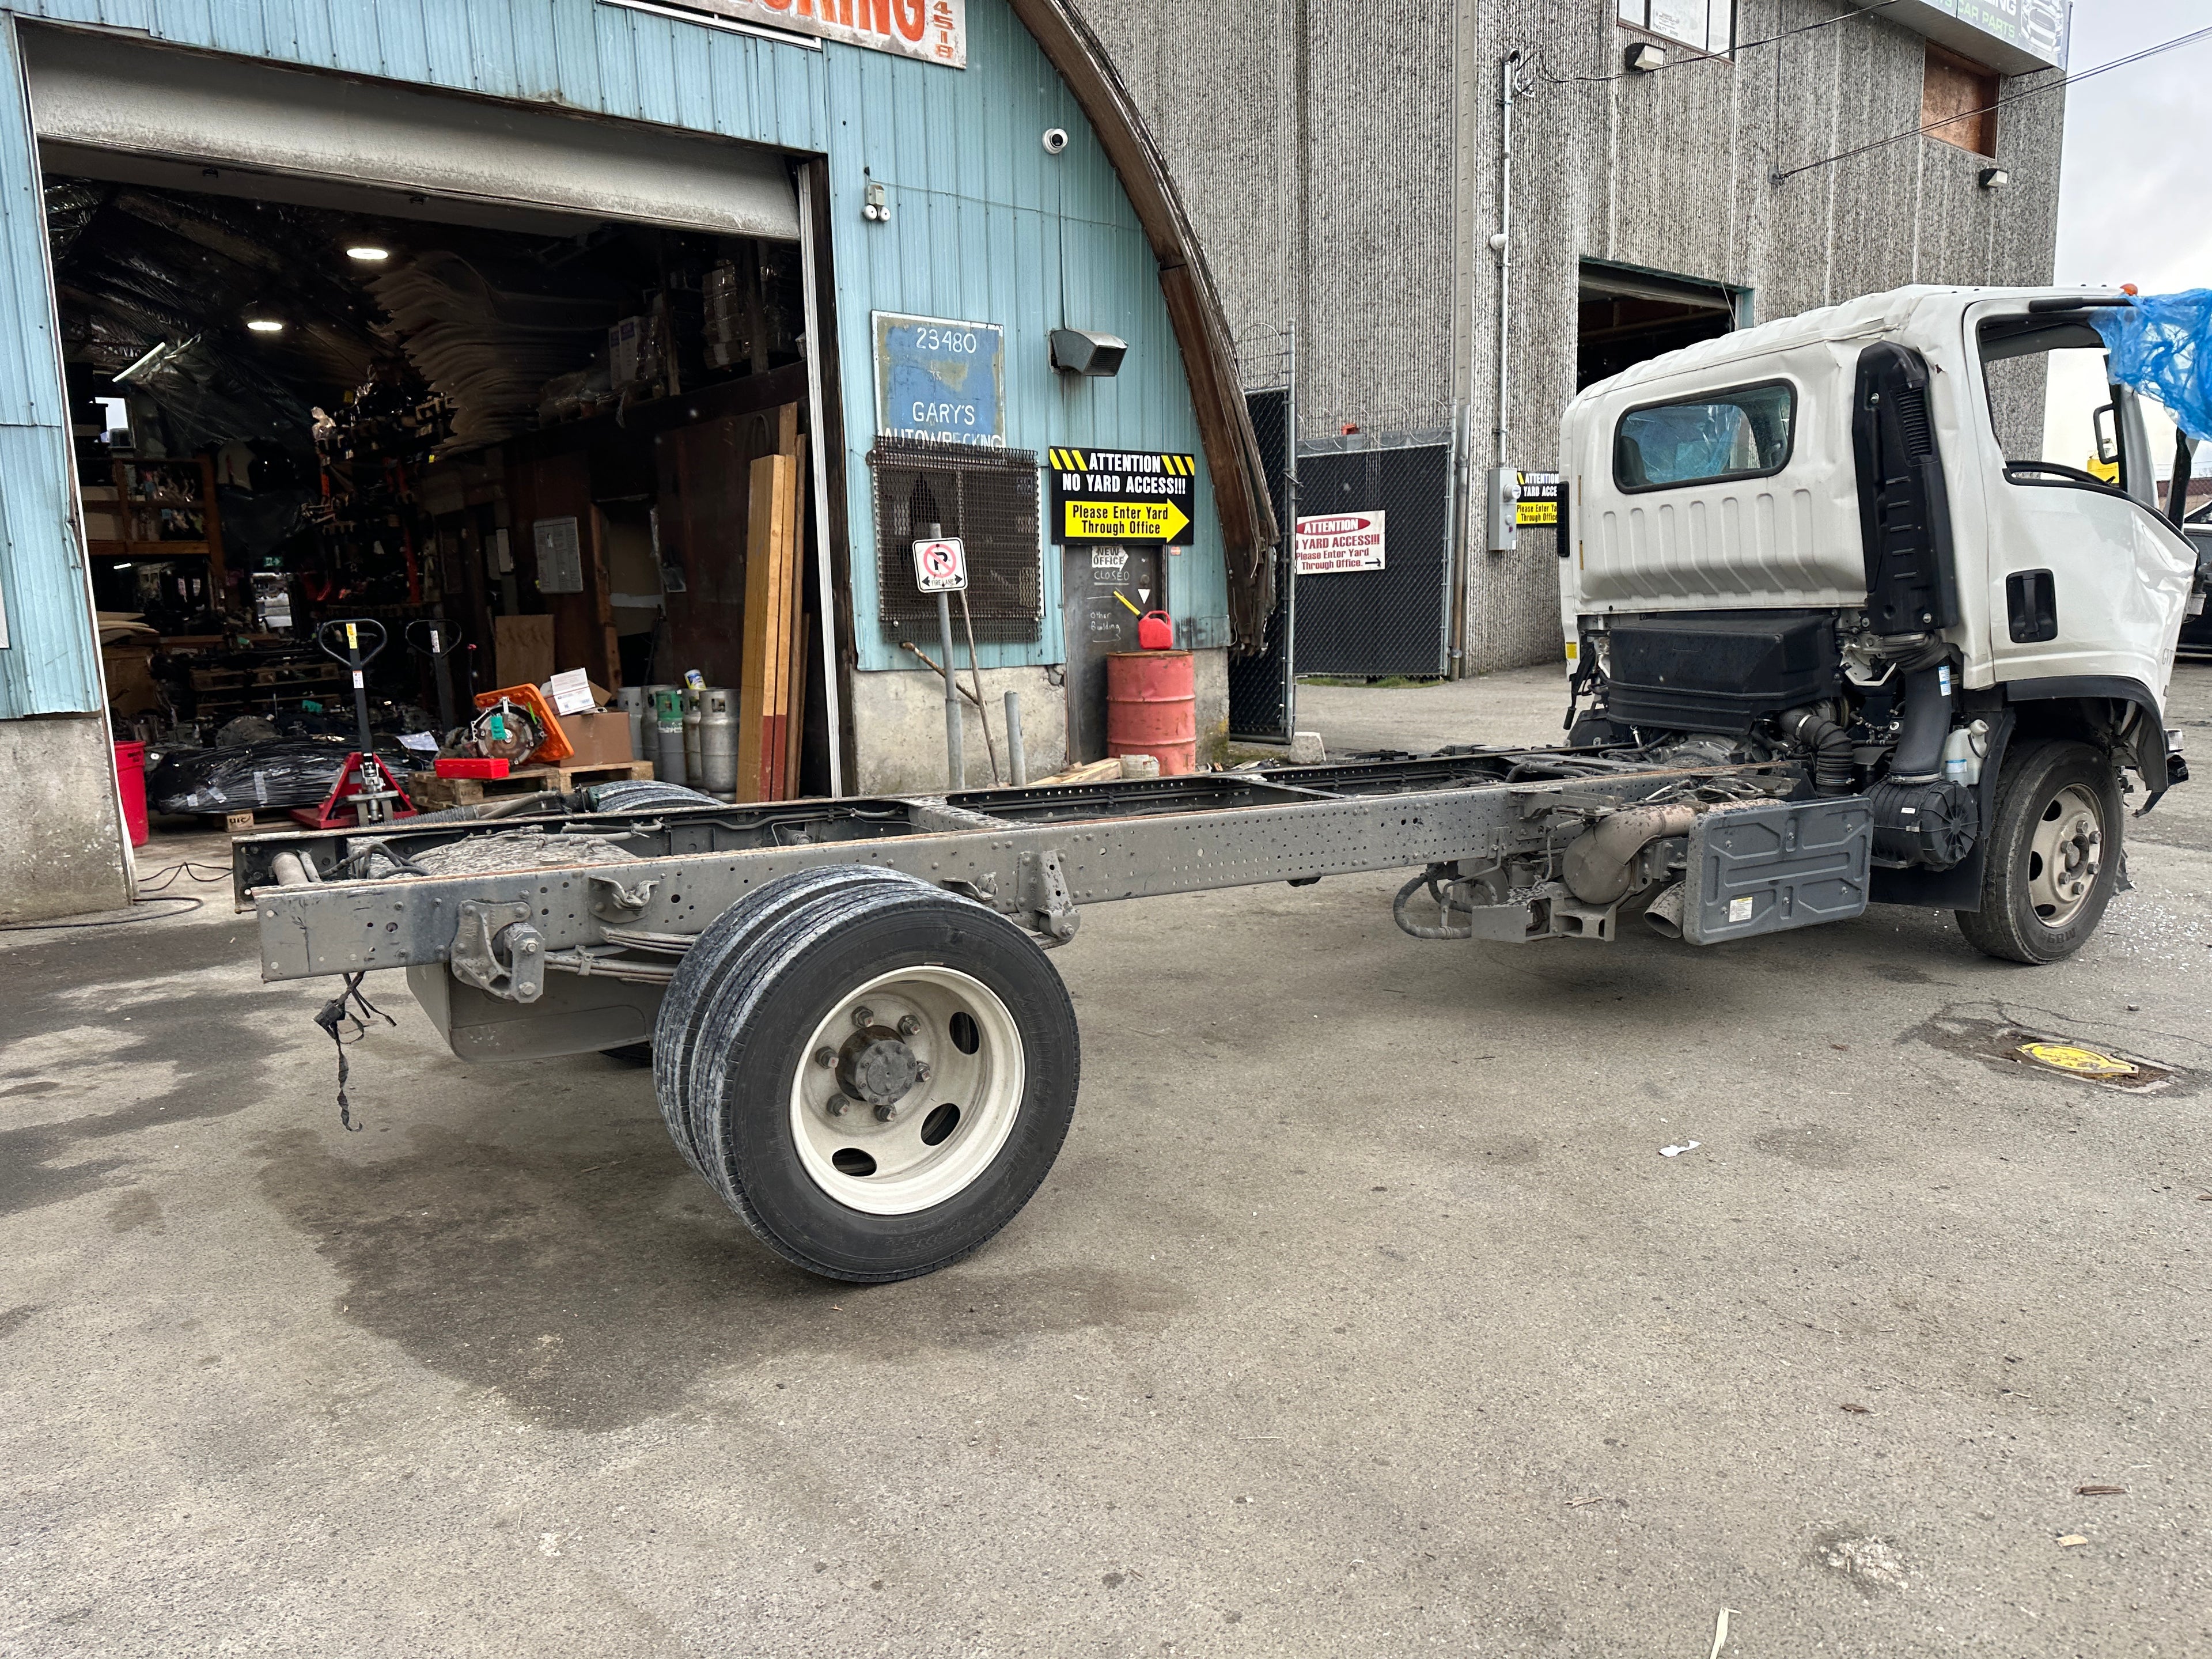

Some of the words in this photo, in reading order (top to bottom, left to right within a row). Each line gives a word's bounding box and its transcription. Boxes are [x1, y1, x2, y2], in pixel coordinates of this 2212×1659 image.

[1982, 10, 2015, 38] PARTS
[916, 327, 976, 354] 23480
[912, 401, 975, 426] GARY'S
[1089, 453, 1161, 473] ATTENTION
[1062, 473, 1081, 491] NO
[1086, 474, 1120, 493] YARD
[1126, 476, 1185, 494] ACCESS!!!
[1525, 473, 1559, 484] ATTENTION
[1523, 486, 1540, 497] YARD
[1073, 505, 1108, 518] Please
[1113, 506, 1141, 520] Enter
[1146, 506, 1168, 520] Yard
[1517, 505, 1533, 513] Please
[1536, 504, 1549, 512] Enter
[1521, 513, 1541, 522] Through
[1543, 513, 1558, 521] Office
[1081, 520, 1124, 536] Through
[1130, 521, 1160, 534] Office
[1304, 519, 1358, 534] ATTENTION
[1302, 537, 1329, 550] YARD
[1332, 534, 1380, 548] ACCESS!!!
[1096, 547, 1119, 556] NEW
[1296, 552, 1321, 560] Please
[1324, 550, 1346, 559] Enter
[1349, 548, 1369, 557] Yard
[1094, 556, 1124, 565] OFFICE
[1302, 560, 1334, 570] Through
[1094, 570, 1130, 581] CLOSED
